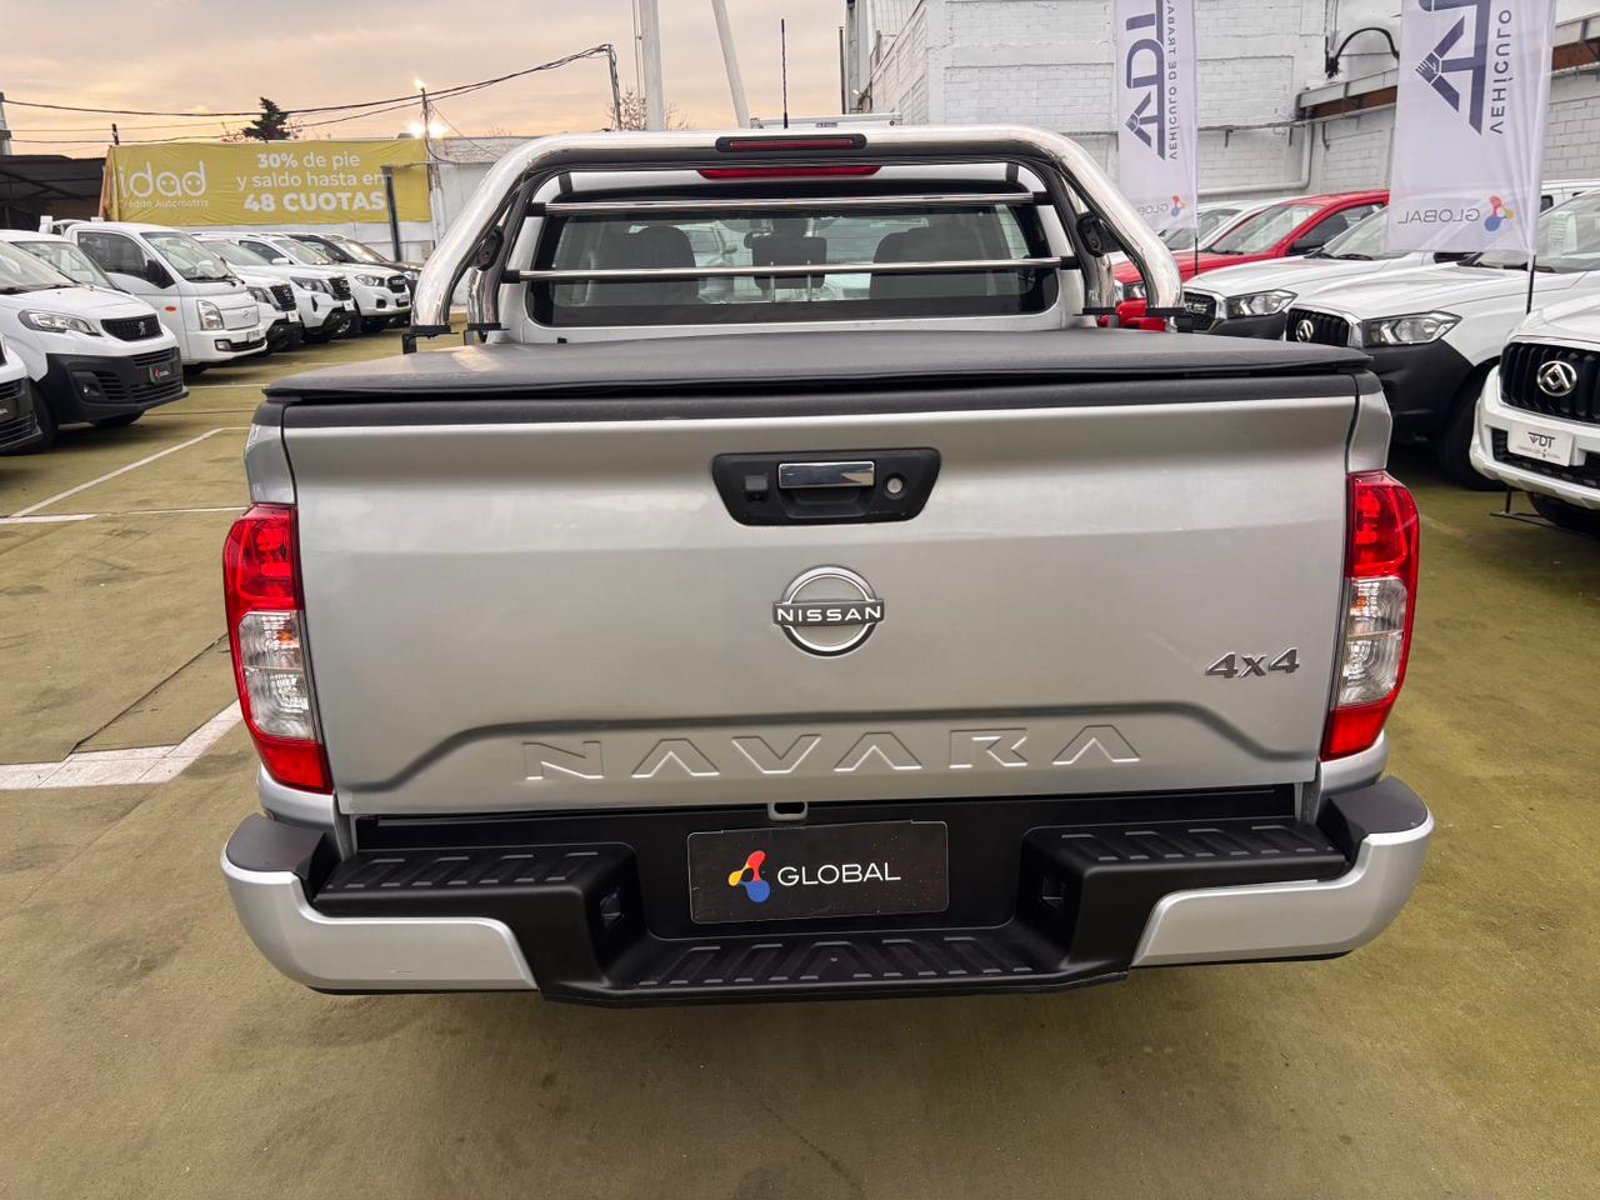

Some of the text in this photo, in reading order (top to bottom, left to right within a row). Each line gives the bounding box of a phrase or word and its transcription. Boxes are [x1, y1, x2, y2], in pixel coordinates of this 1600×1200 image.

[257, 151, 361, 170] 30% de pie
[236, 171, 385, 191] y saldo hasta en
[243, 190, 386, 212] 48 CUOTAS
[777, 606, 882, 622] NISSAN
[1205, 647, 1300, 678] 4x4
[522, 725, 1141, 780] NAVARA
[777, 862, 901, 886] GLOBAL
